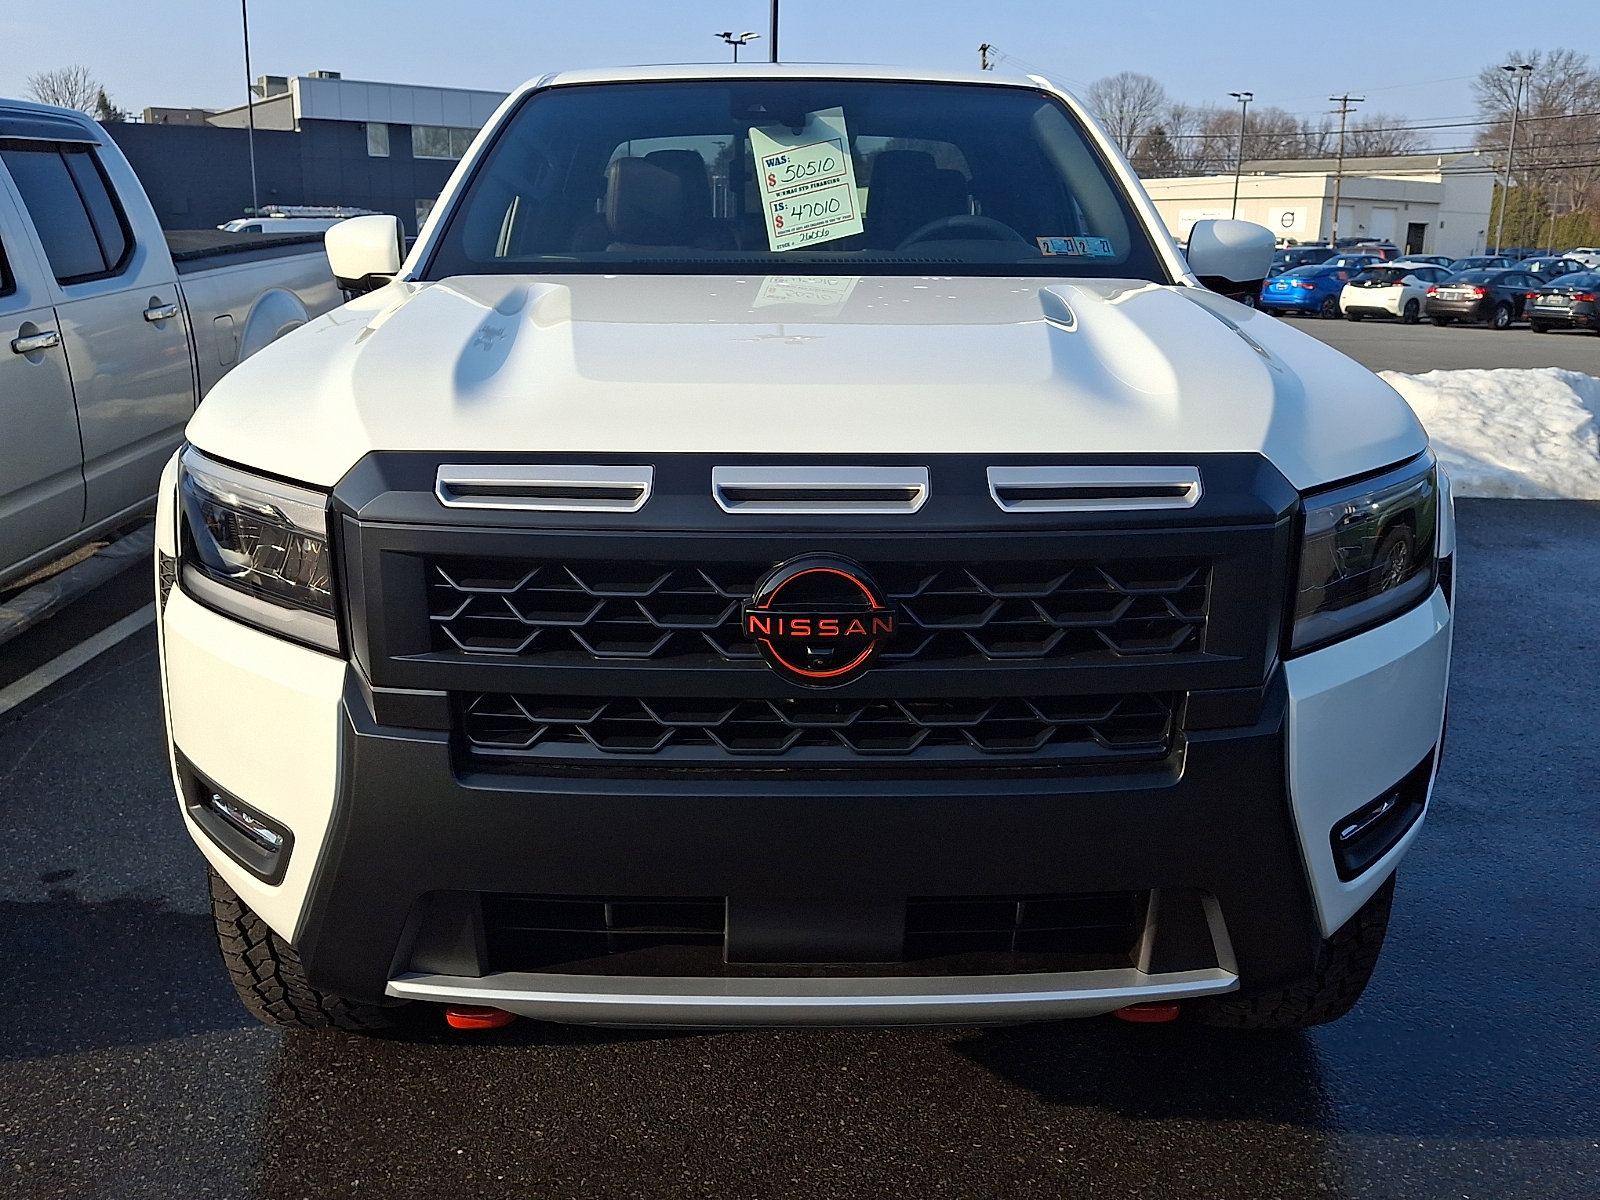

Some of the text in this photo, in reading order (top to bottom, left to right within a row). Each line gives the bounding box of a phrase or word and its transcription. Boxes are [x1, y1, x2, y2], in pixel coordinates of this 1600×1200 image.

[766, 155, 790, 167] WAS:
[768, 158, 834, 187] $ 50510
[774, 202, 788, 212] IS:
[775, 214, 784, 229] $
[791, 198, 840, 220] 47010
[749, 616, 893, 636] NISSAN
